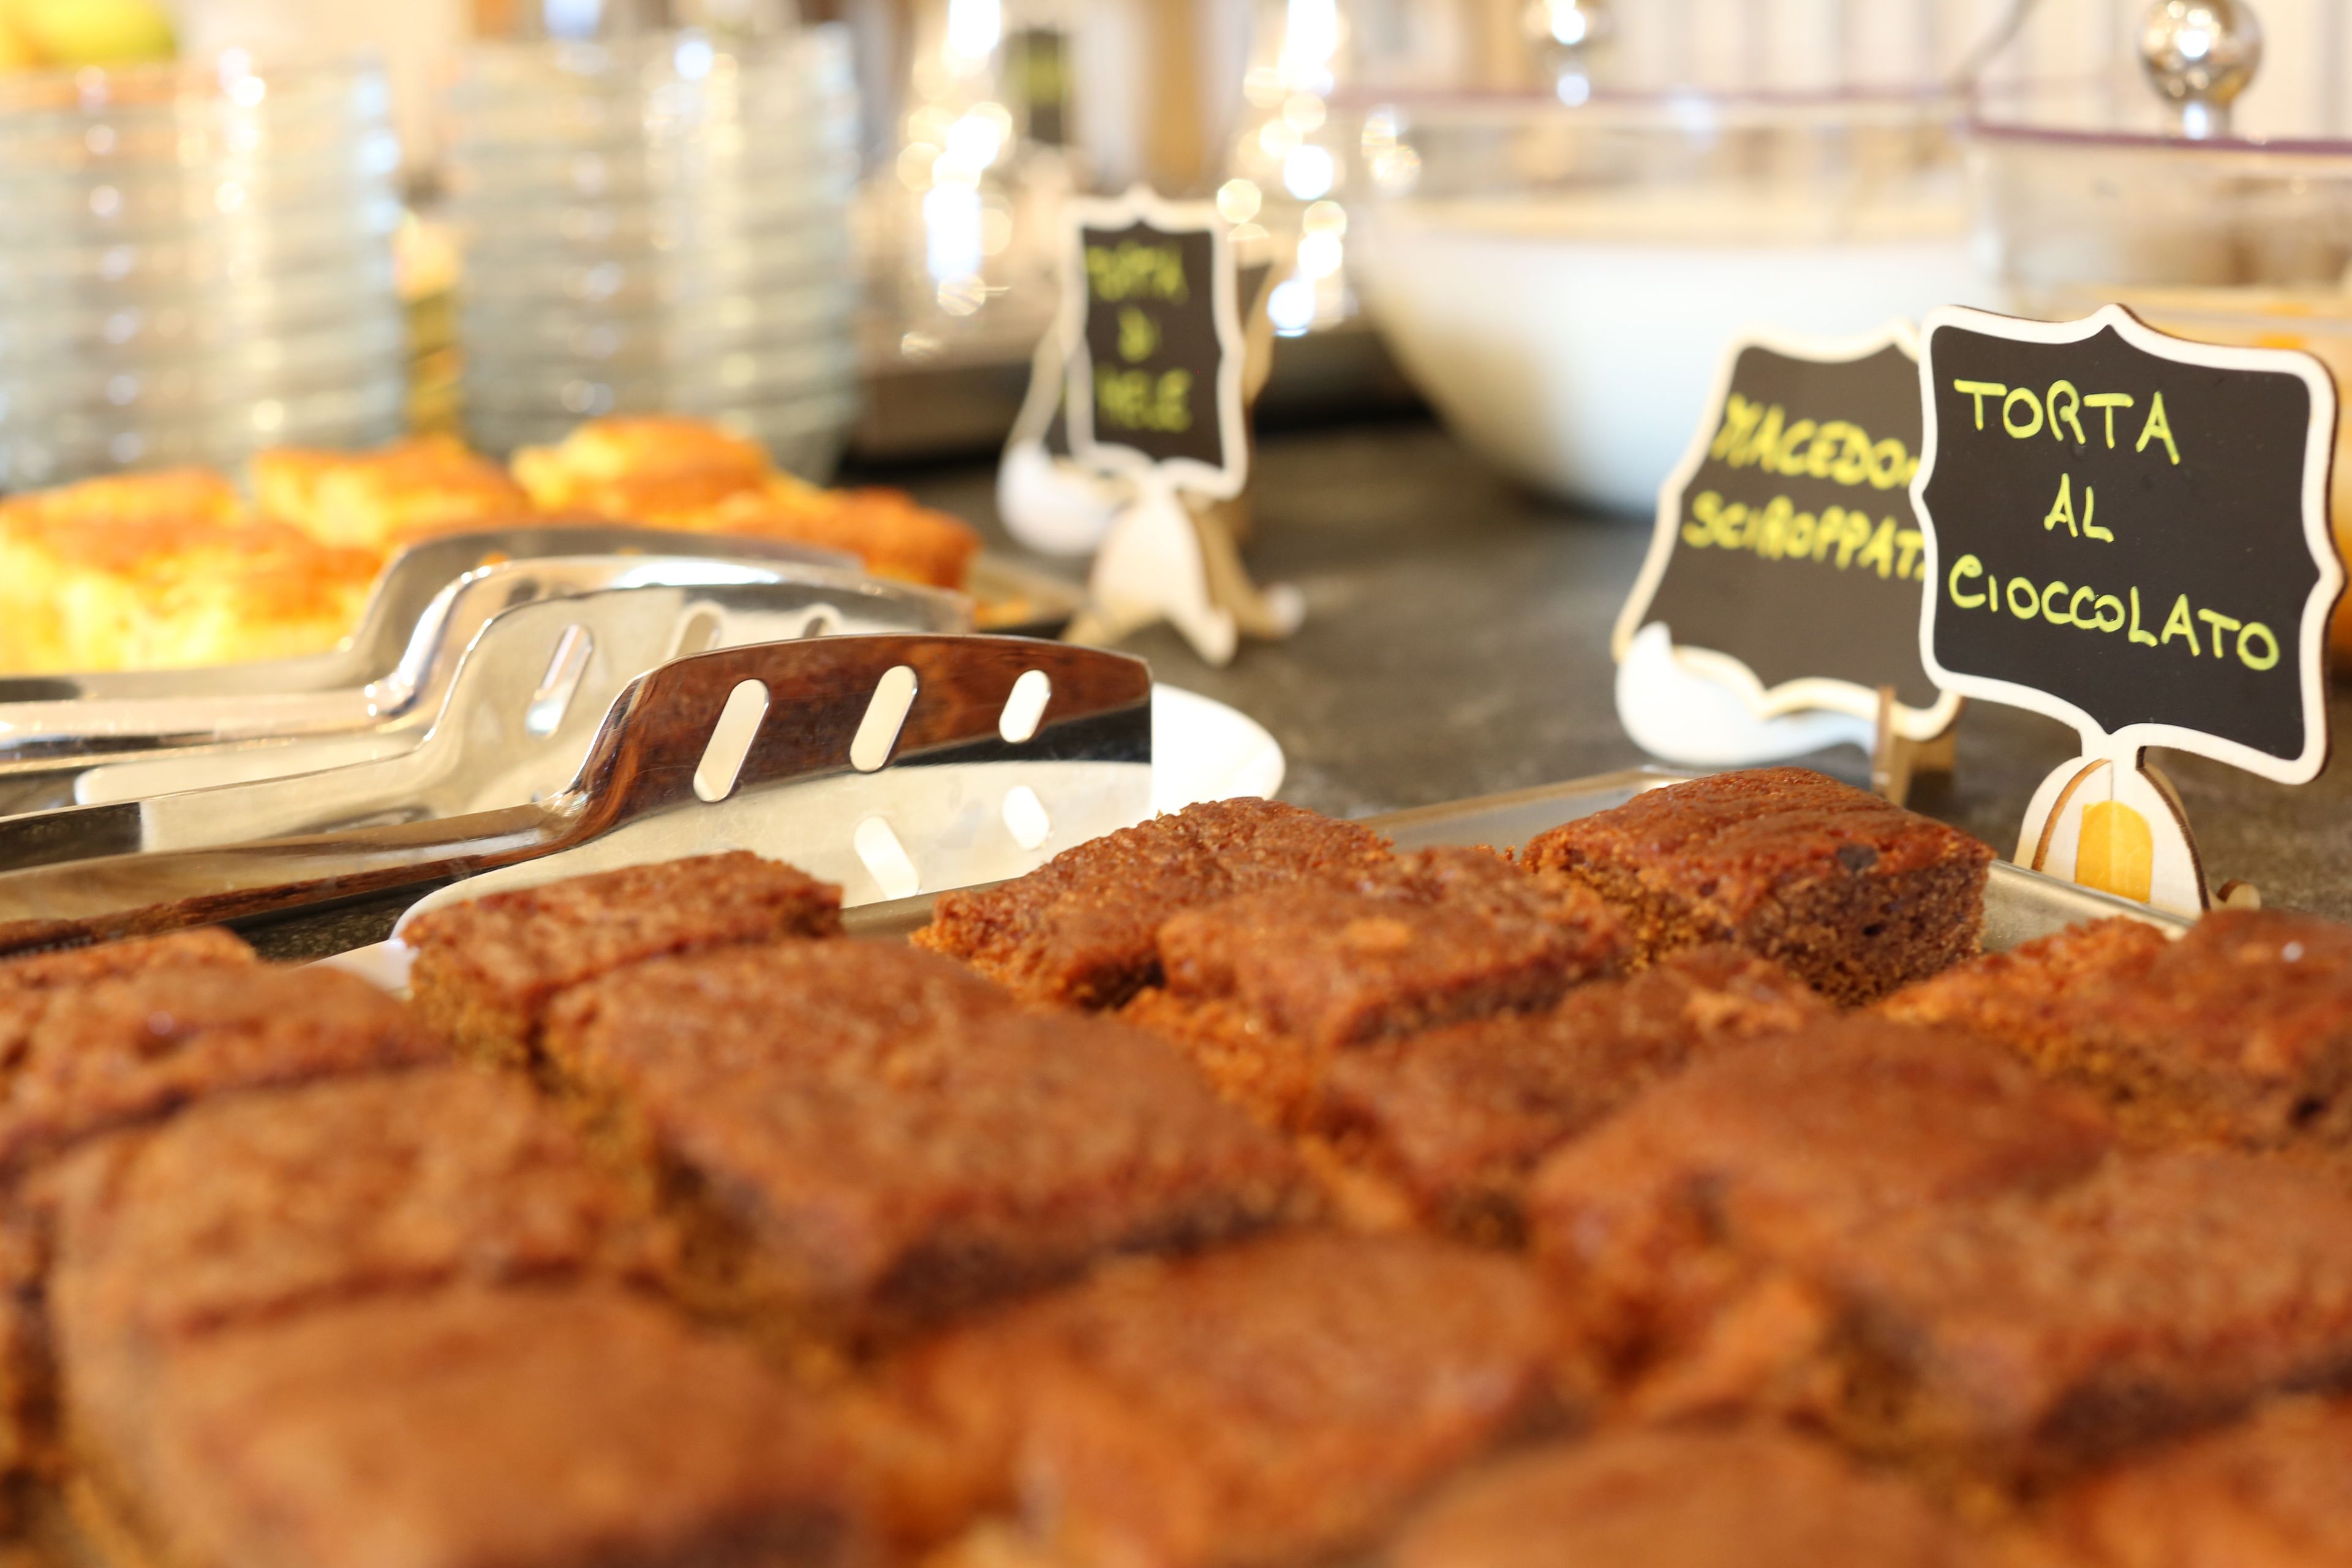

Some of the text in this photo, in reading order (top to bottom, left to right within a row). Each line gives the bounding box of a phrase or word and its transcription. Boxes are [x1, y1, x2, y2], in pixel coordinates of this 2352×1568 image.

[1953, 378, 2180, 466] TORTA
[1682, 489, 1924, 580] SCIROPPAT
[2044, 473, 2114, 543] AL
[1948, 554, 2280, 671] CIOCCOLATO
